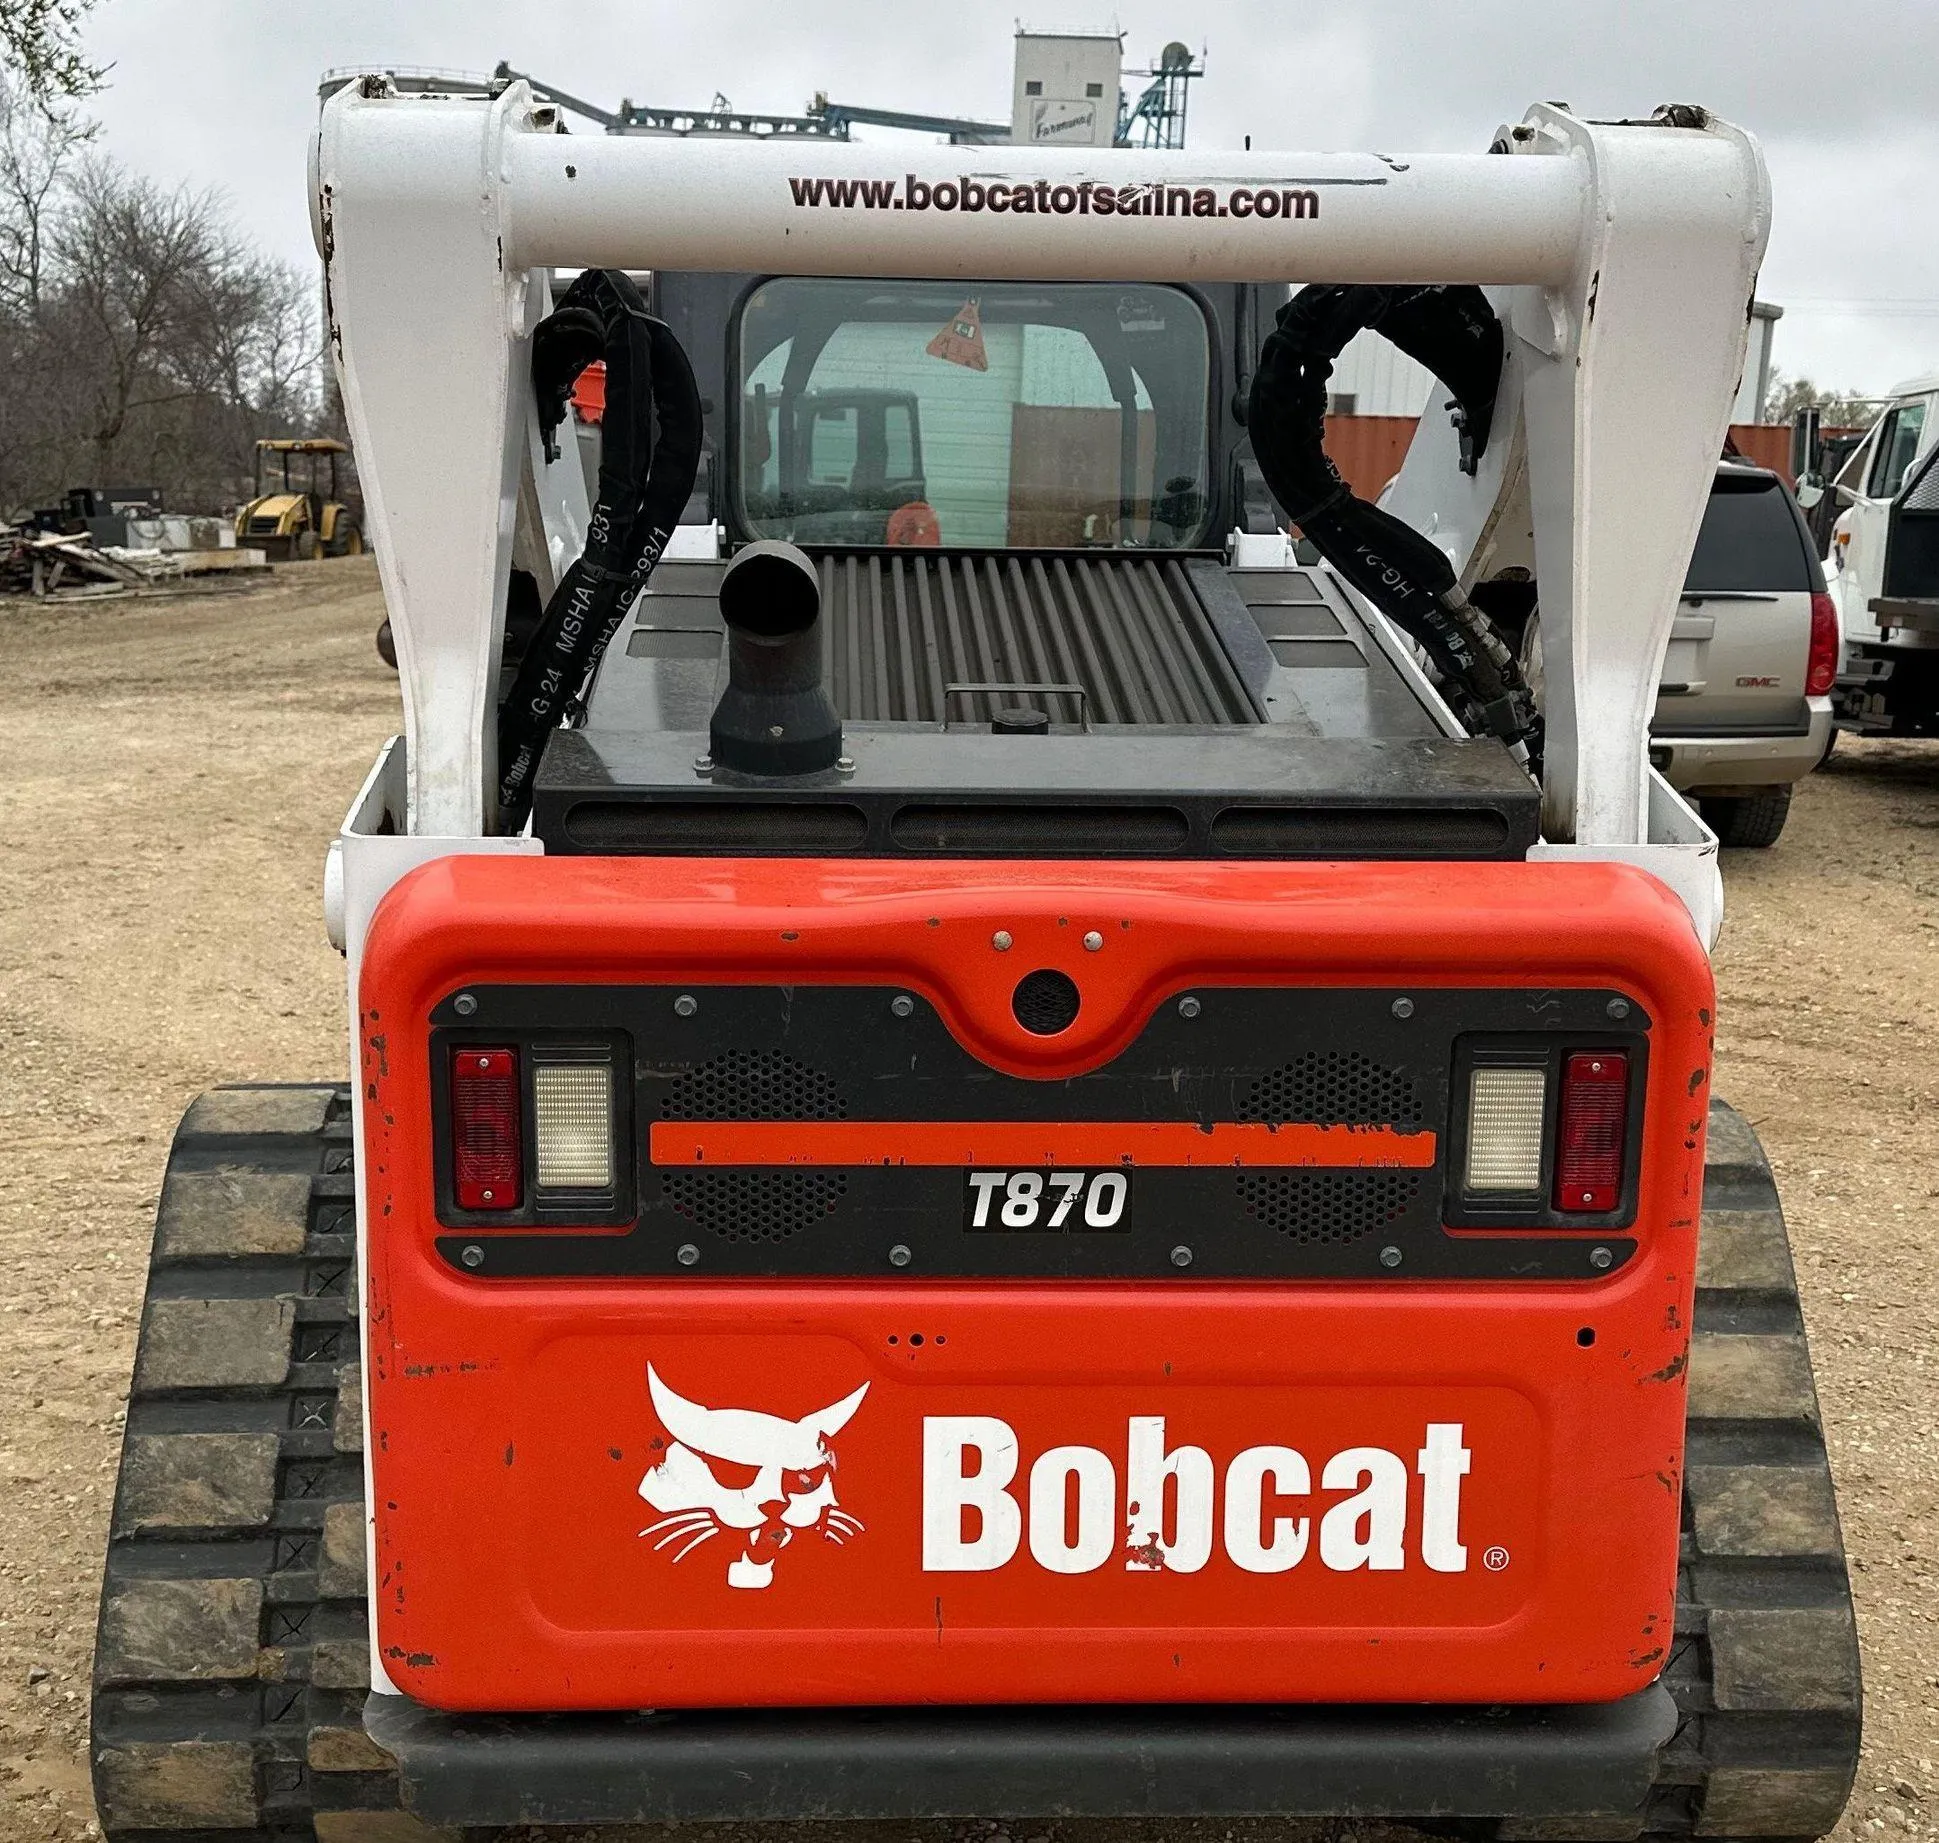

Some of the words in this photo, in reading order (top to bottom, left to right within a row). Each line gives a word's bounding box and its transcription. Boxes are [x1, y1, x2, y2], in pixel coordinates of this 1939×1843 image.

[555, 586, 595, 654] MSHA
[1735, 676, 1781, 688] GMC
[969, 1172, 1127, 1228] T870
[922, 1415, 1471, 1574] Bobcat
